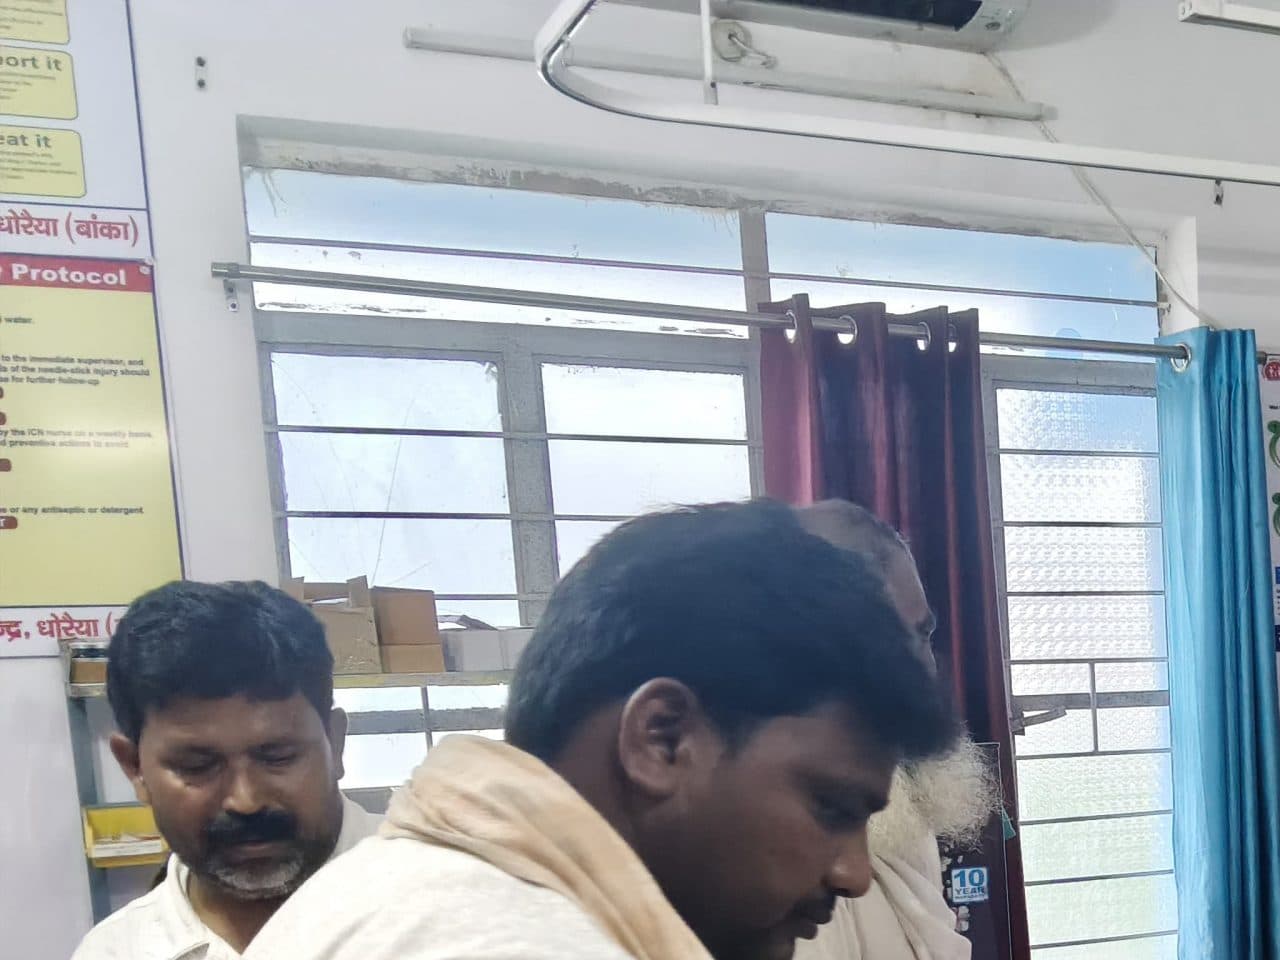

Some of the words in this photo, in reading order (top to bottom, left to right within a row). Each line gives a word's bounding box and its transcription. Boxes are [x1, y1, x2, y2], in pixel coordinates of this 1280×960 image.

[46, 57, 62, 72] it
[36, 134, 51, 148] it
[11, 262, 127, 285] Protocol
[36, 611, 99, 638] धोरैया
[953, 869, 985, 888] 10
[954, 887, 986, 896] YEAR
